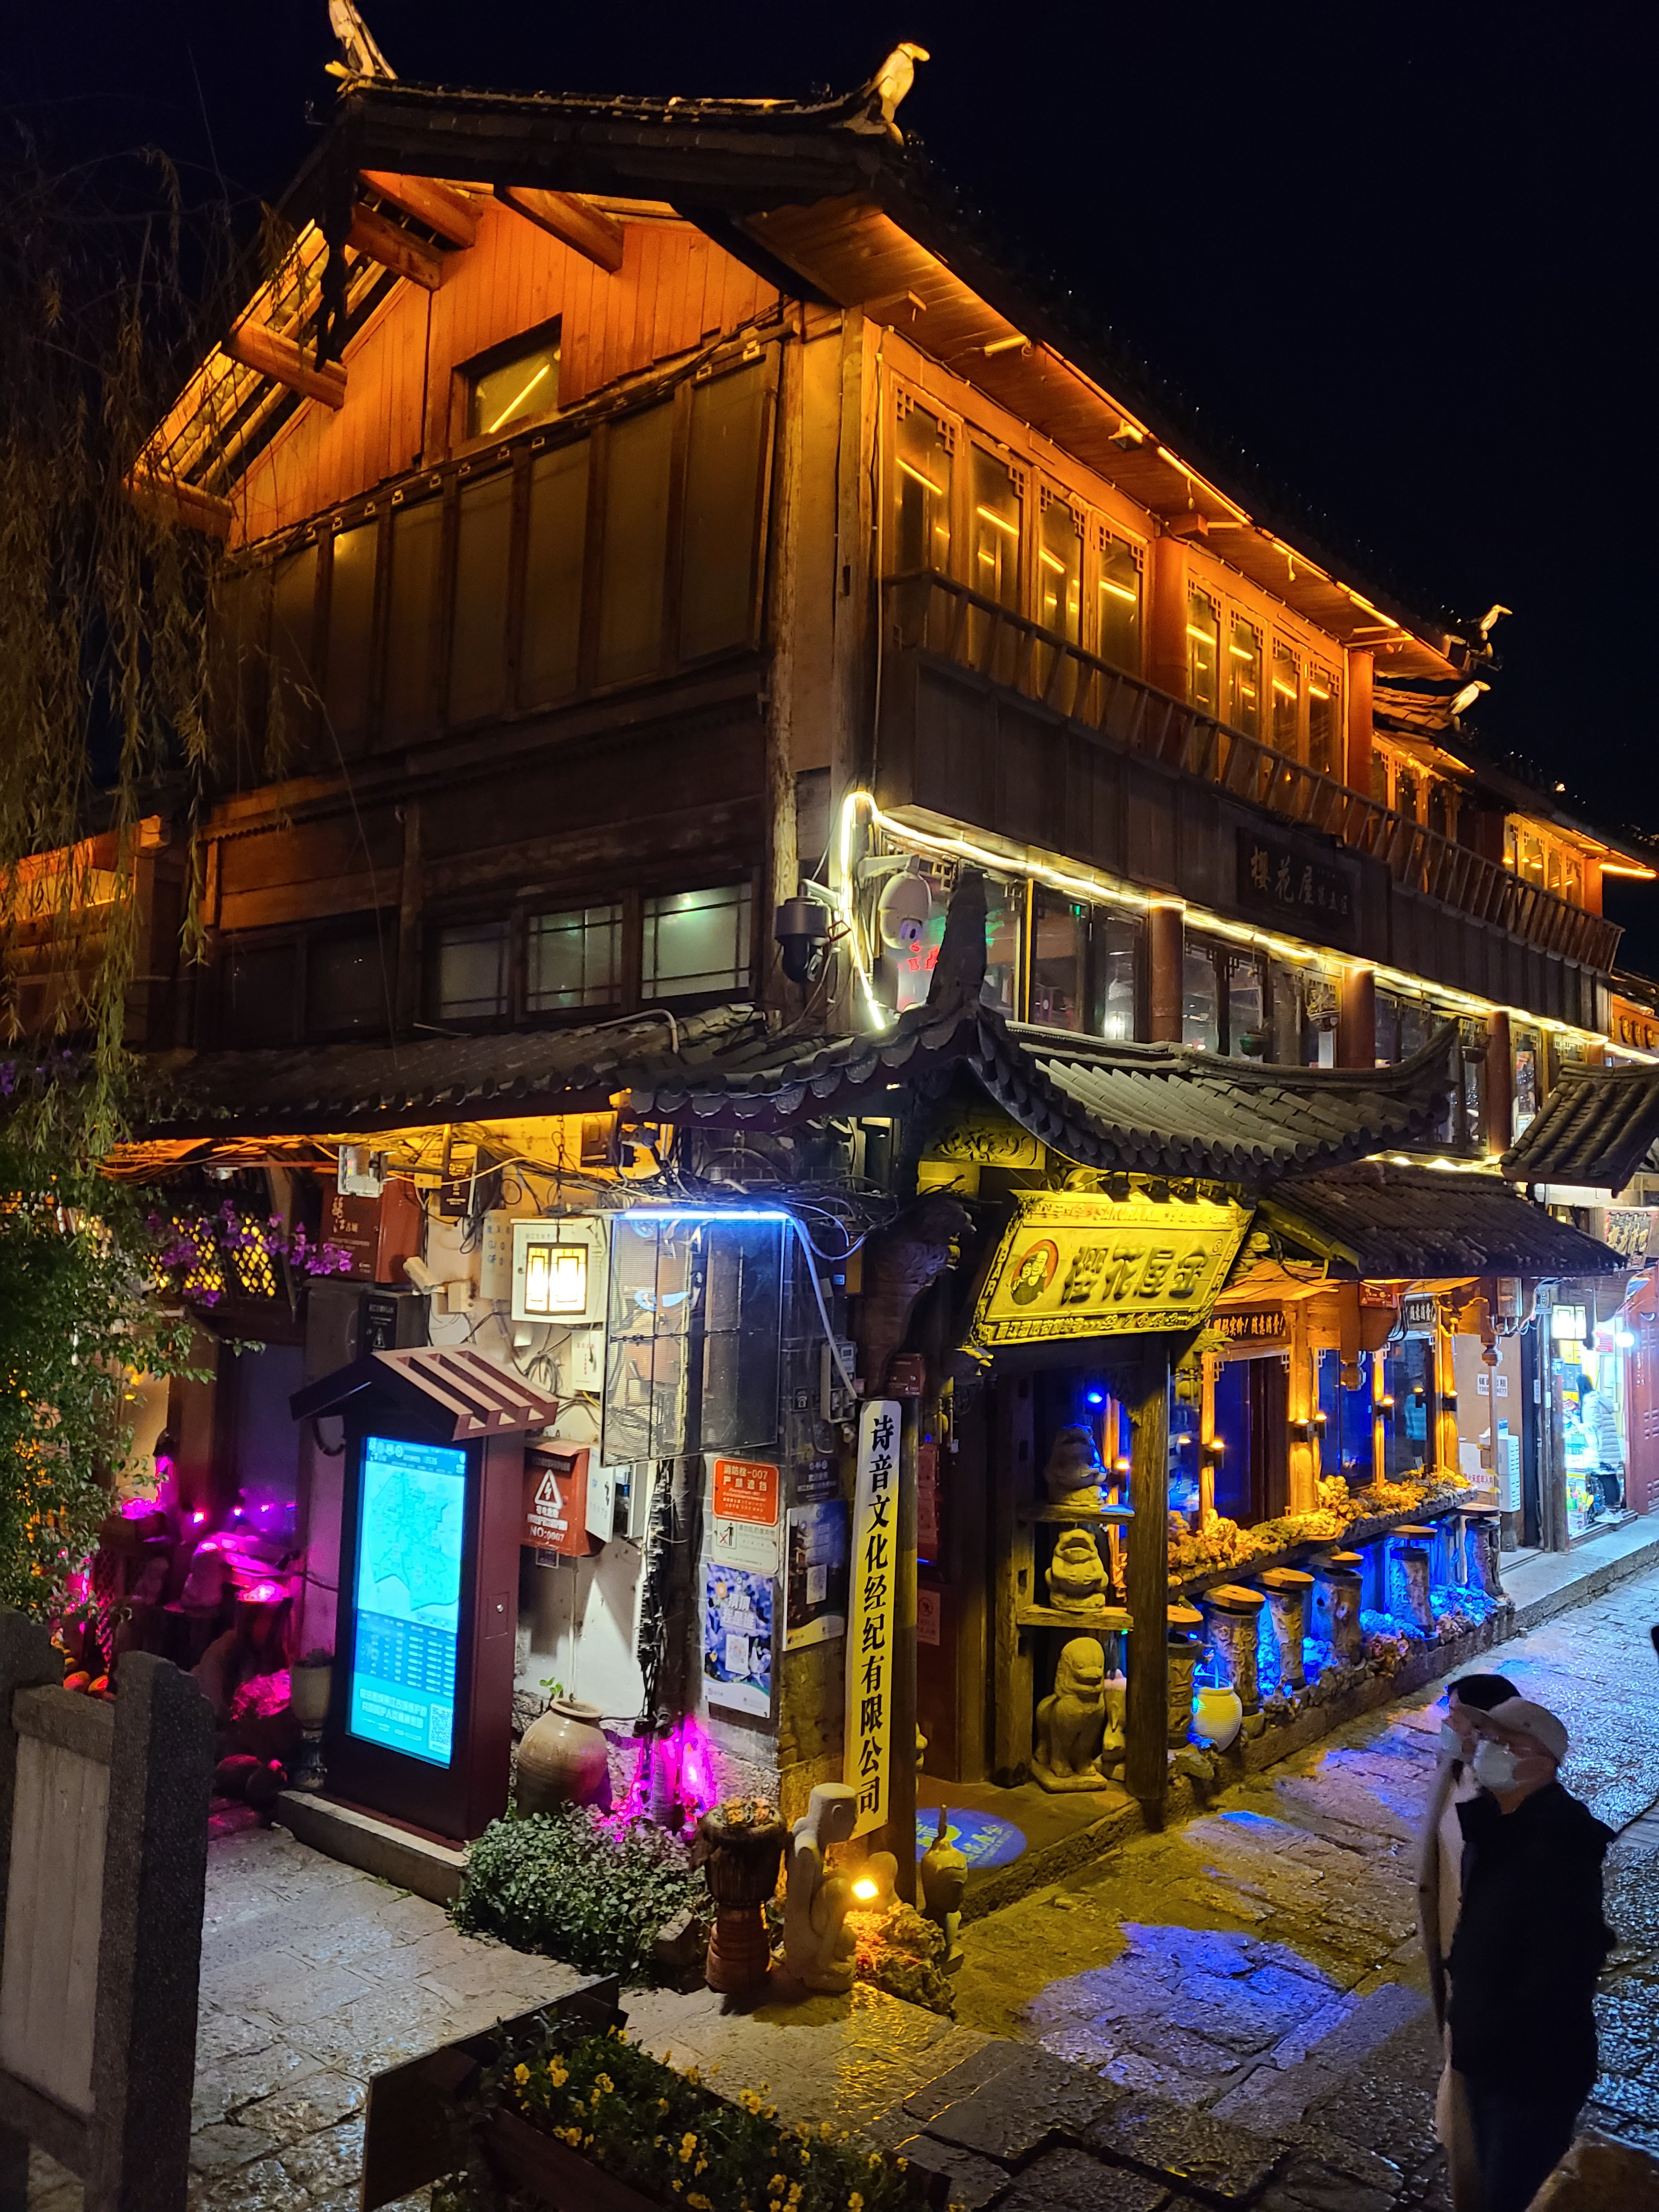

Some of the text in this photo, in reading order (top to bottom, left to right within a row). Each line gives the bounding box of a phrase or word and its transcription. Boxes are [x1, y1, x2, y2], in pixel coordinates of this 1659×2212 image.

[985, 1246, 1009, 1297] BAR
[1211, 1246, 1234, 1292] BAR
[724, 1464, 768, 1480] 消防栓-007
[858, 1414, 895, 1815] 诗音文化经纪有限公司
